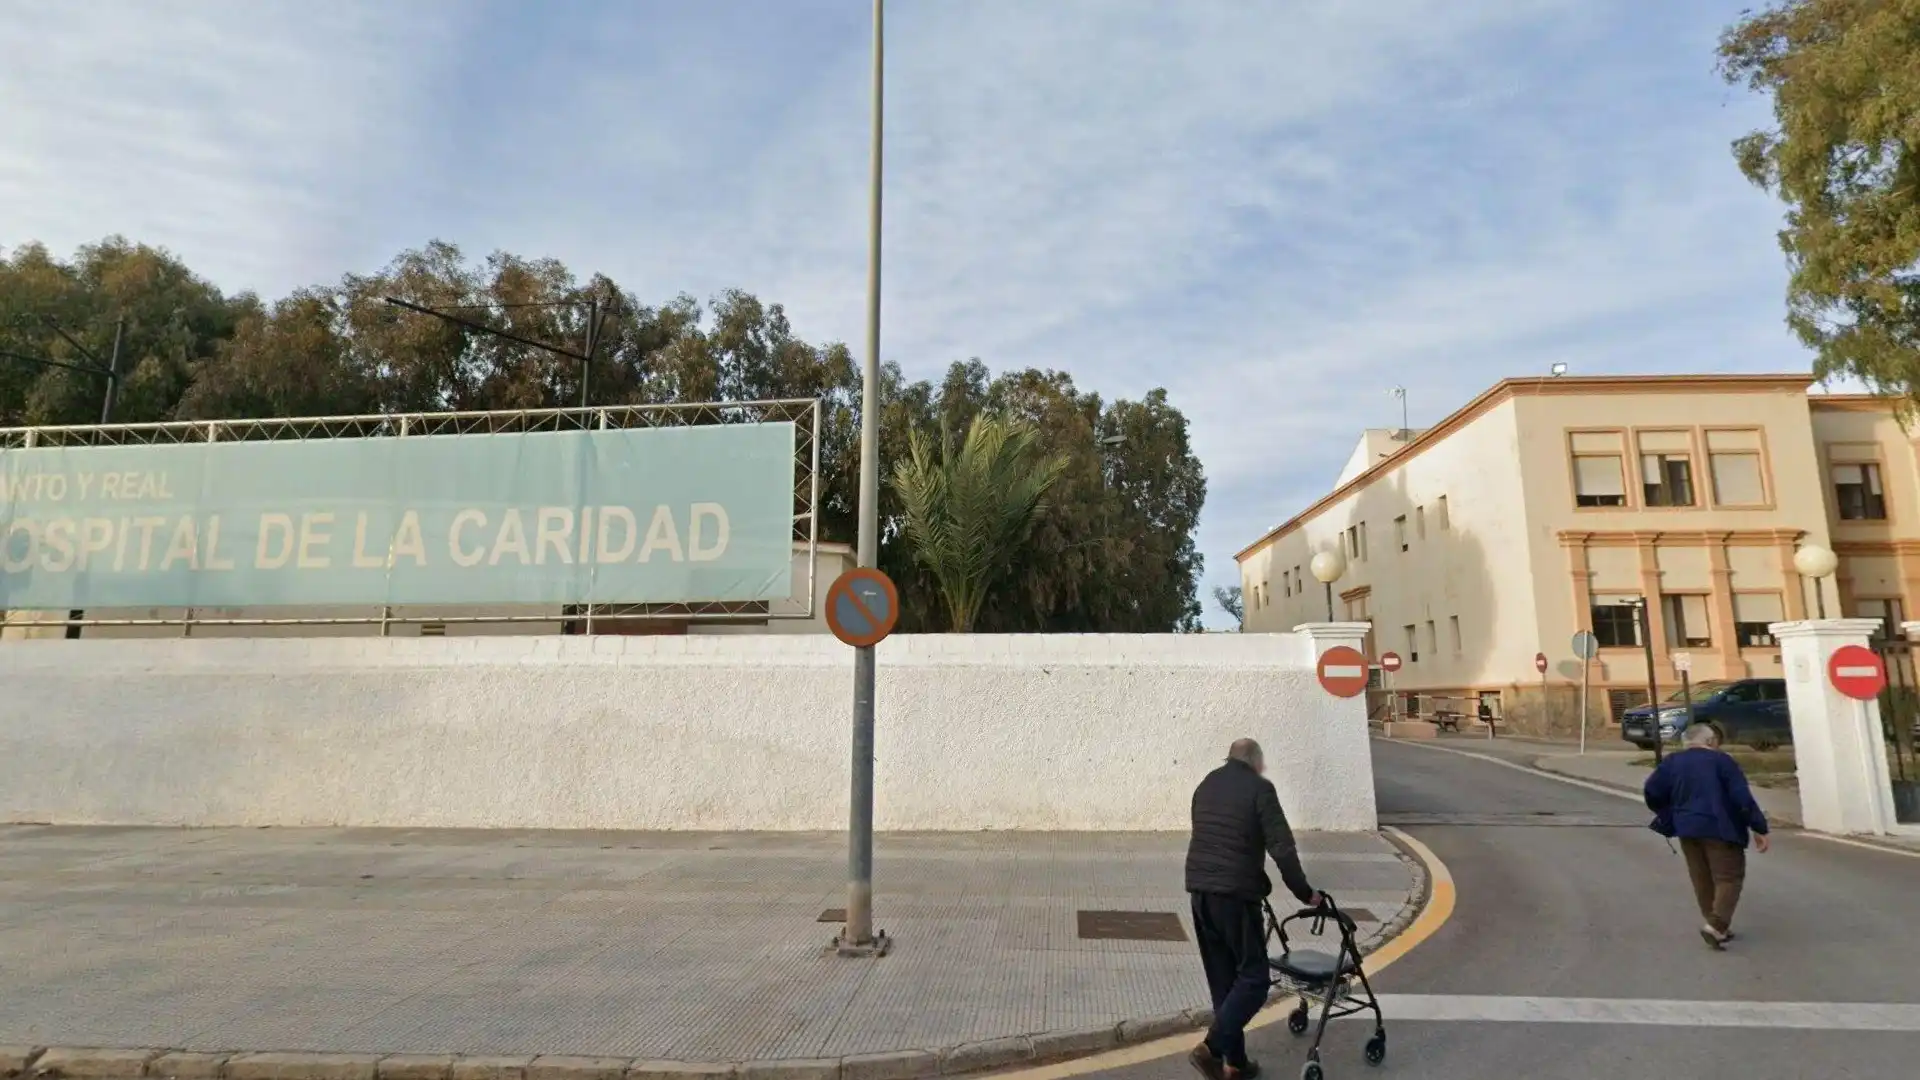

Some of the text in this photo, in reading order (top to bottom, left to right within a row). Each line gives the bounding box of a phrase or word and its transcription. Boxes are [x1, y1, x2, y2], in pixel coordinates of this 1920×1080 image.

[77, 472, 94, 500] Y
[102, 471, 173, 499] REAL
[255, 512, 335, 569] DE
[352, 509, 427, 568] LA
[449, 502, 730, 567] CARIDAD
